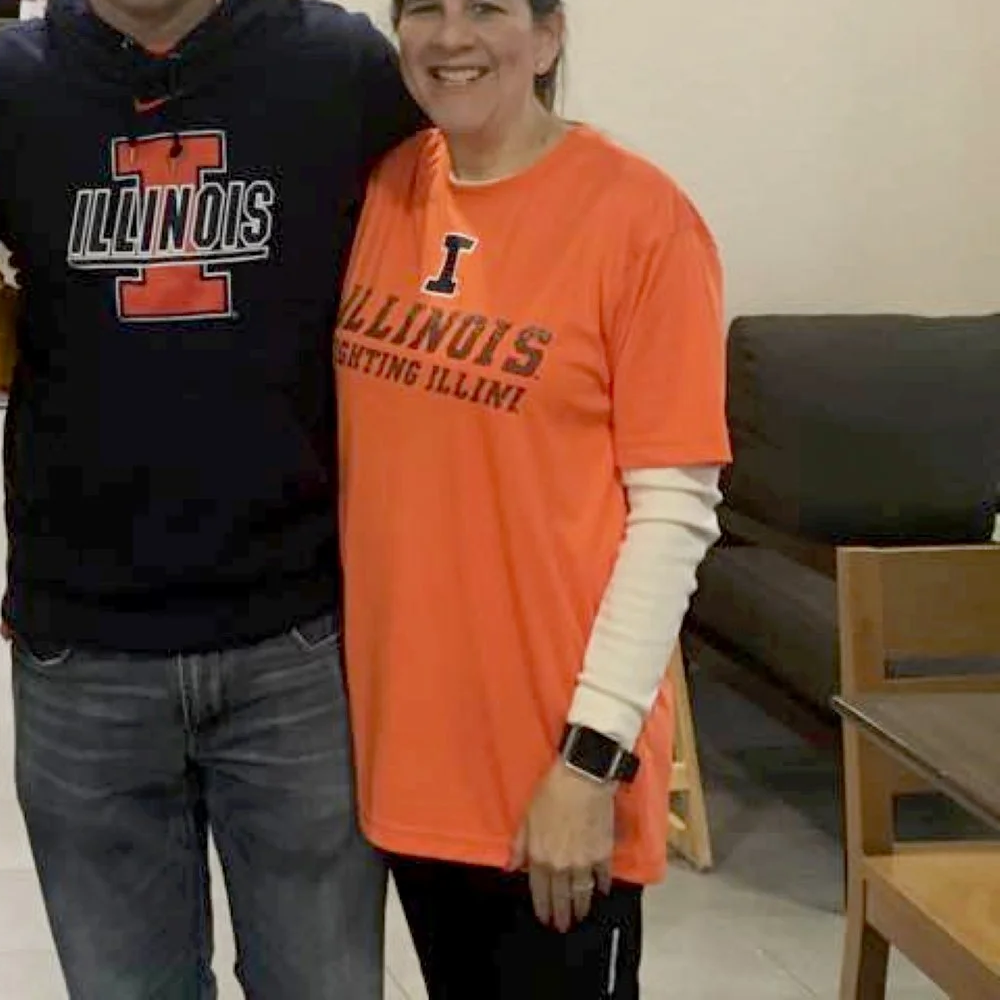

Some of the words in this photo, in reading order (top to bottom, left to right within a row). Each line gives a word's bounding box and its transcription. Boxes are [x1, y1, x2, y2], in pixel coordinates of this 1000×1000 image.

[67, 180, 276, 257] ILLINOIS
[420, 232, 479, 298] I
[336, 284, 553, 377] ILLINOIS
[335, 338, 422, 386] GHTING
[425, 365, 528, 414] ILLINI
